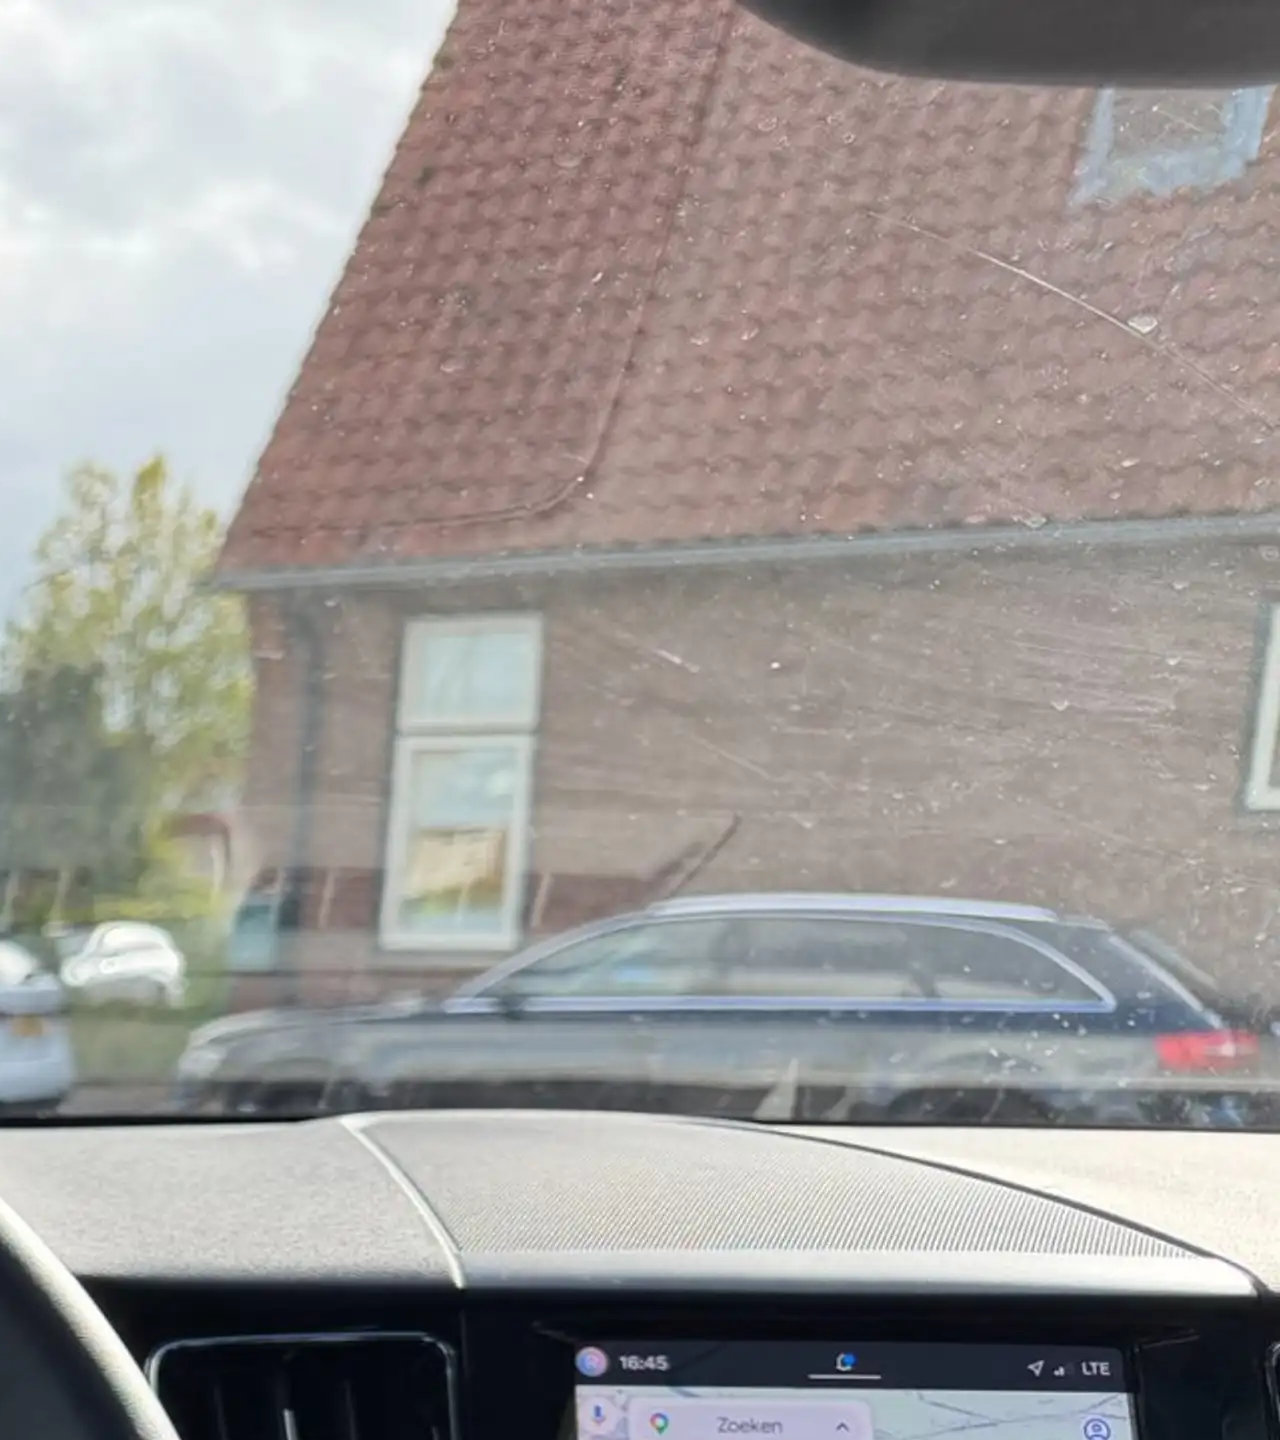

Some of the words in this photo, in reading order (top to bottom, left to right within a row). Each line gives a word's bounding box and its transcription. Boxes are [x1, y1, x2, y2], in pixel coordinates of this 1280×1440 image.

[619, 1355, 670, 1371] 16:45
[1081, 1361, 1111, 1376] LTE
[716, 1416, 784, 1434] Zoeken
